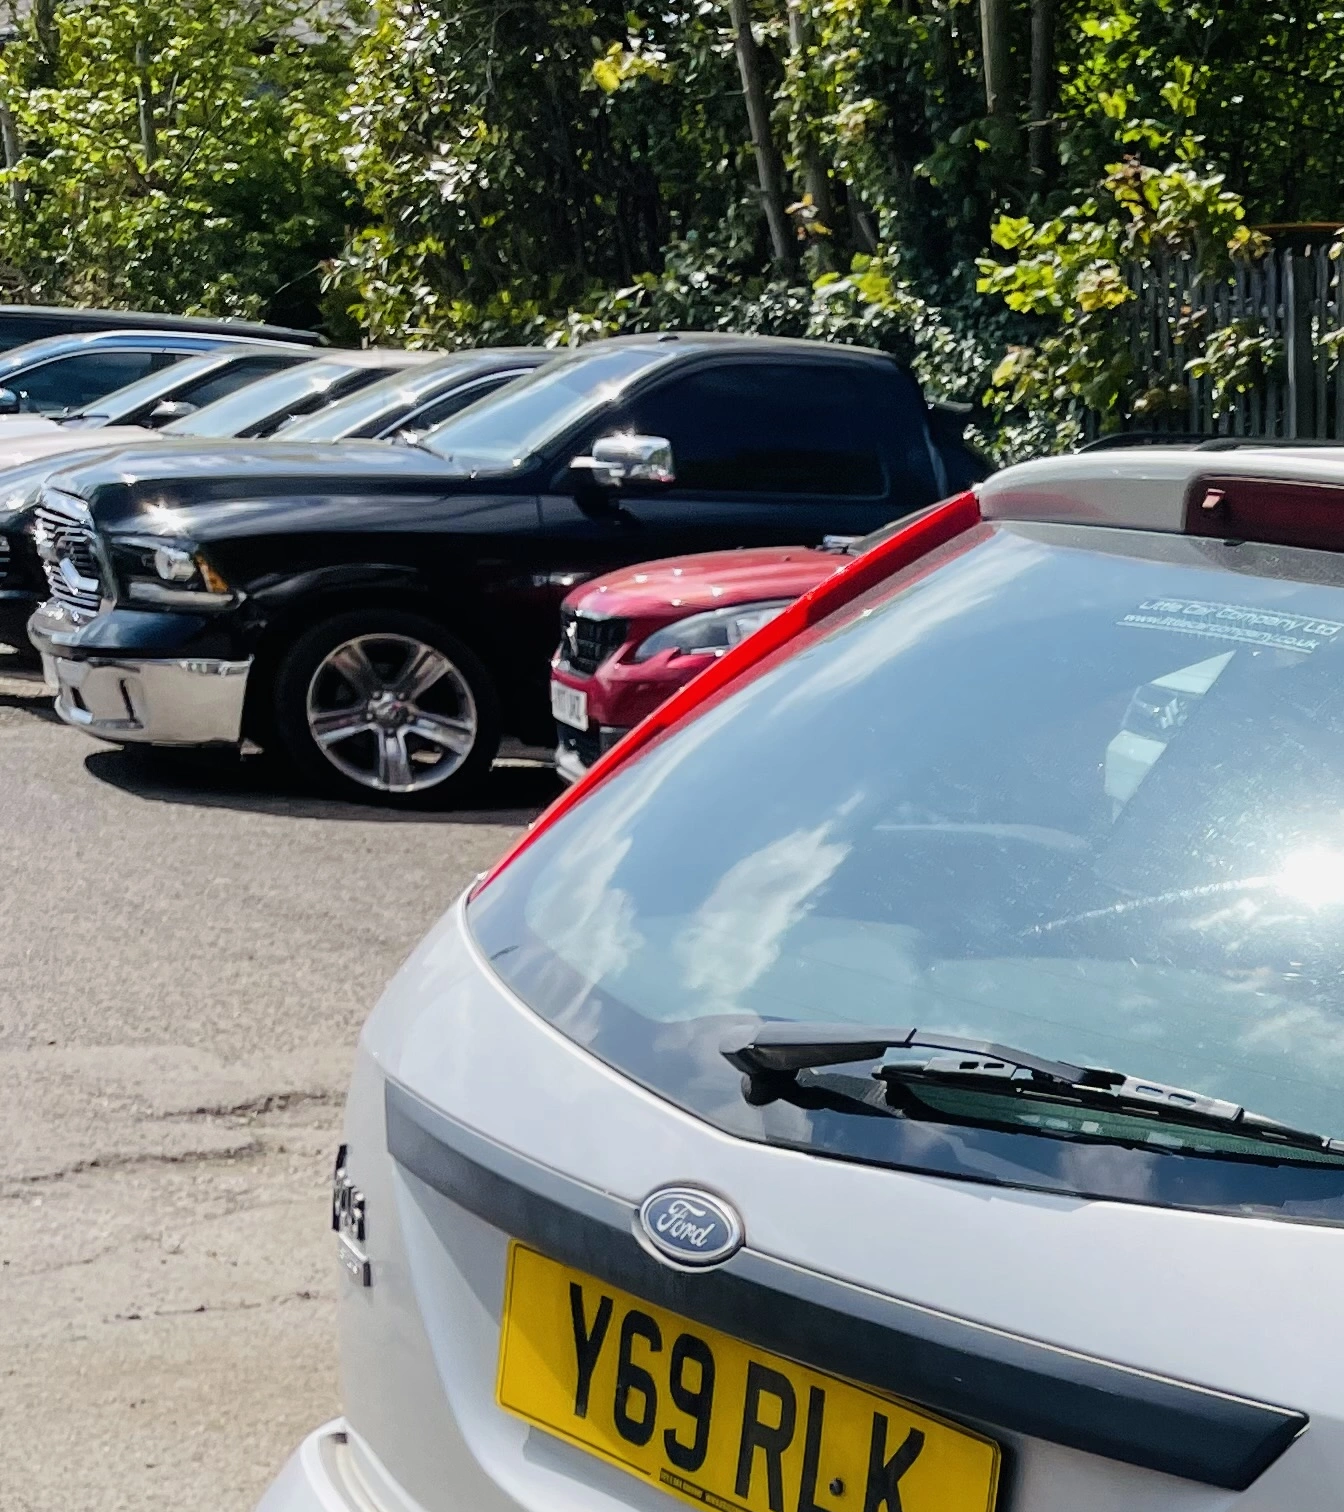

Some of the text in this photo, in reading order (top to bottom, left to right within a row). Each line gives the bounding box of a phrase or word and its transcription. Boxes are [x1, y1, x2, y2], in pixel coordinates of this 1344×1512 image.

[1183, 604, 1214, 616] Car
[1215, 608, 1305, 632] Company
[1303, 621, 1343, 636] Ltd
[656, 1200, 716, 1247] Ford
[568, 1282, 716, 1472] Y69
